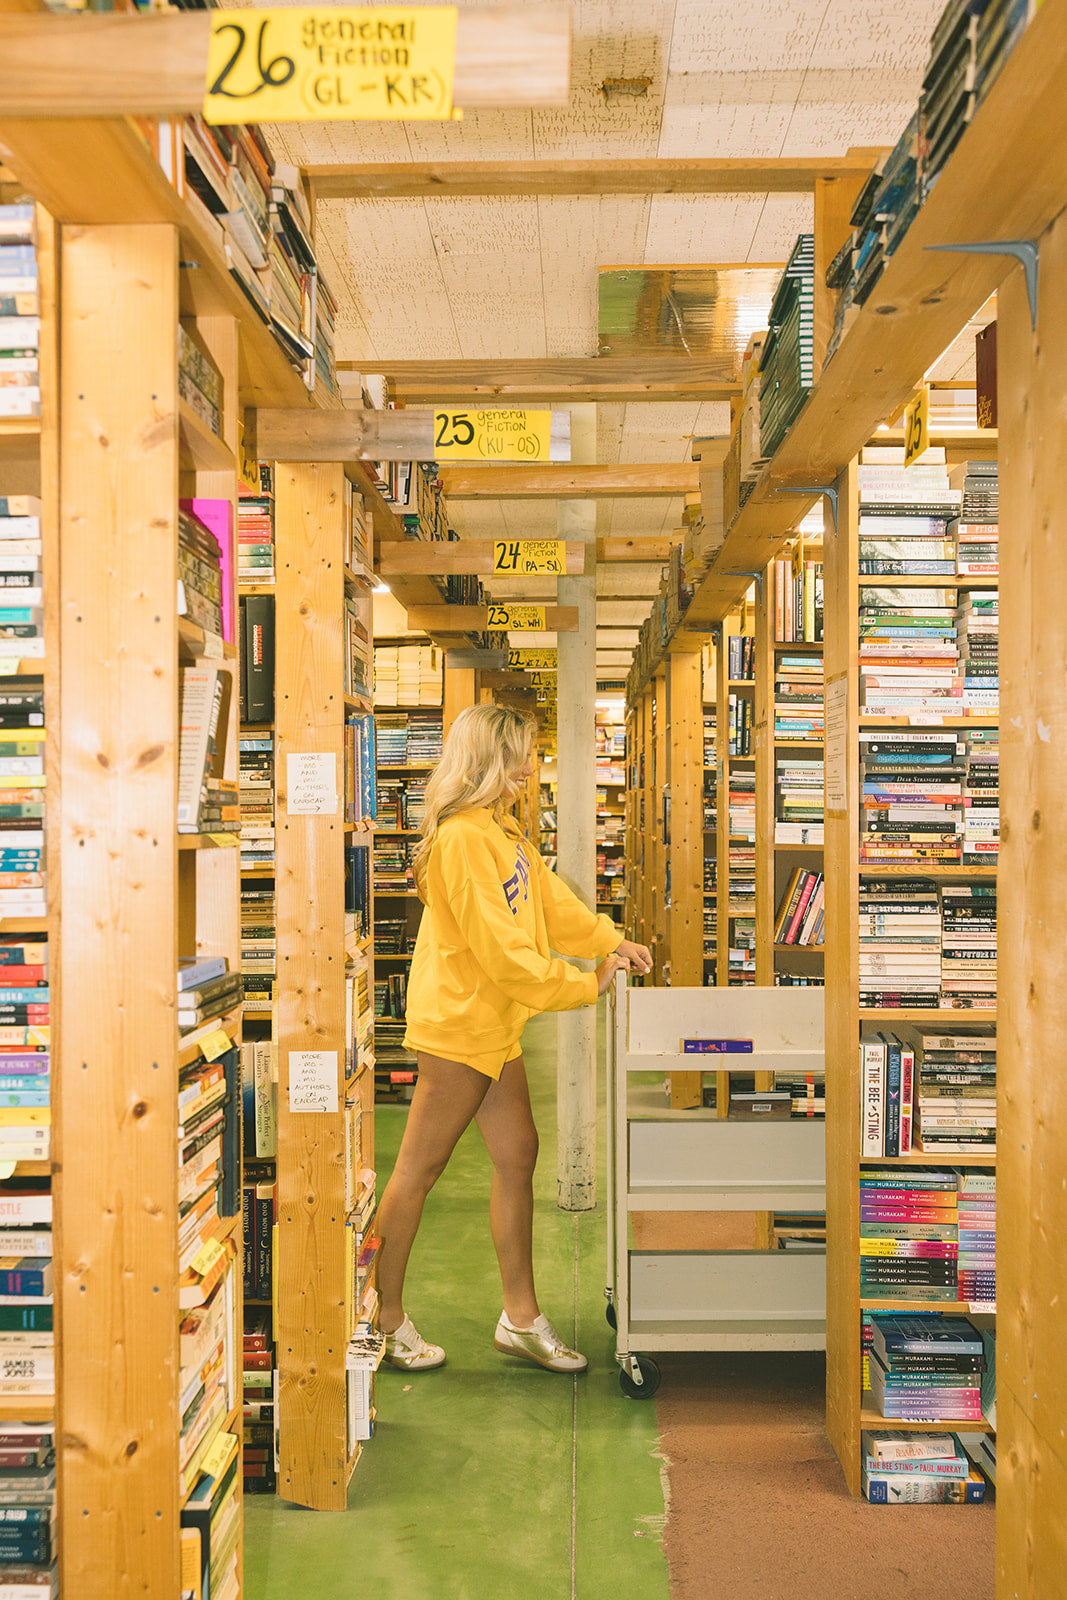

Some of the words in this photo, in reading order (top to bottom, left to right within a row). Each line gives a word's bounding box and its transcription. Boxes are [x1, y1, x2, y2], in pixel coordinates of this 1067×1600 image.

[302, 17, 415, 48] general
[210, 19, 295, 98] 26
[477, 410, 527, 428] general
[486, 421, 527, 432] FICTION
[435, 413, 475, 448] 25
[975, 525, 998, 533] Frida
[523, 541, 559, 553] general
[528, 548, 557, 557] FICTION
[496, 541, 521, 570] 24
[488, 606, 510, 626] 23
[508, 650, 525, 666] 22
[531, 671, 543, 685] 21
[293, 797, 326, 805] ENDCAP
[868, 1067, 880, 1083] THE
[294, 1096, 329, 1105] ENDCAP
[868, 1087, 880, 1103] BEE
[867, 1112, 880, 1140] STING
[3, 1360, 35, 1368] JAMES
[4, 1369, 34, 1377] JONES
[868, 1461, 880, 1470] THE
[894, 1463, 914, 1471] STING
[919, 1464, 935, 1472] PAUL
[936, 1465, 962, 1474] MURRAY
